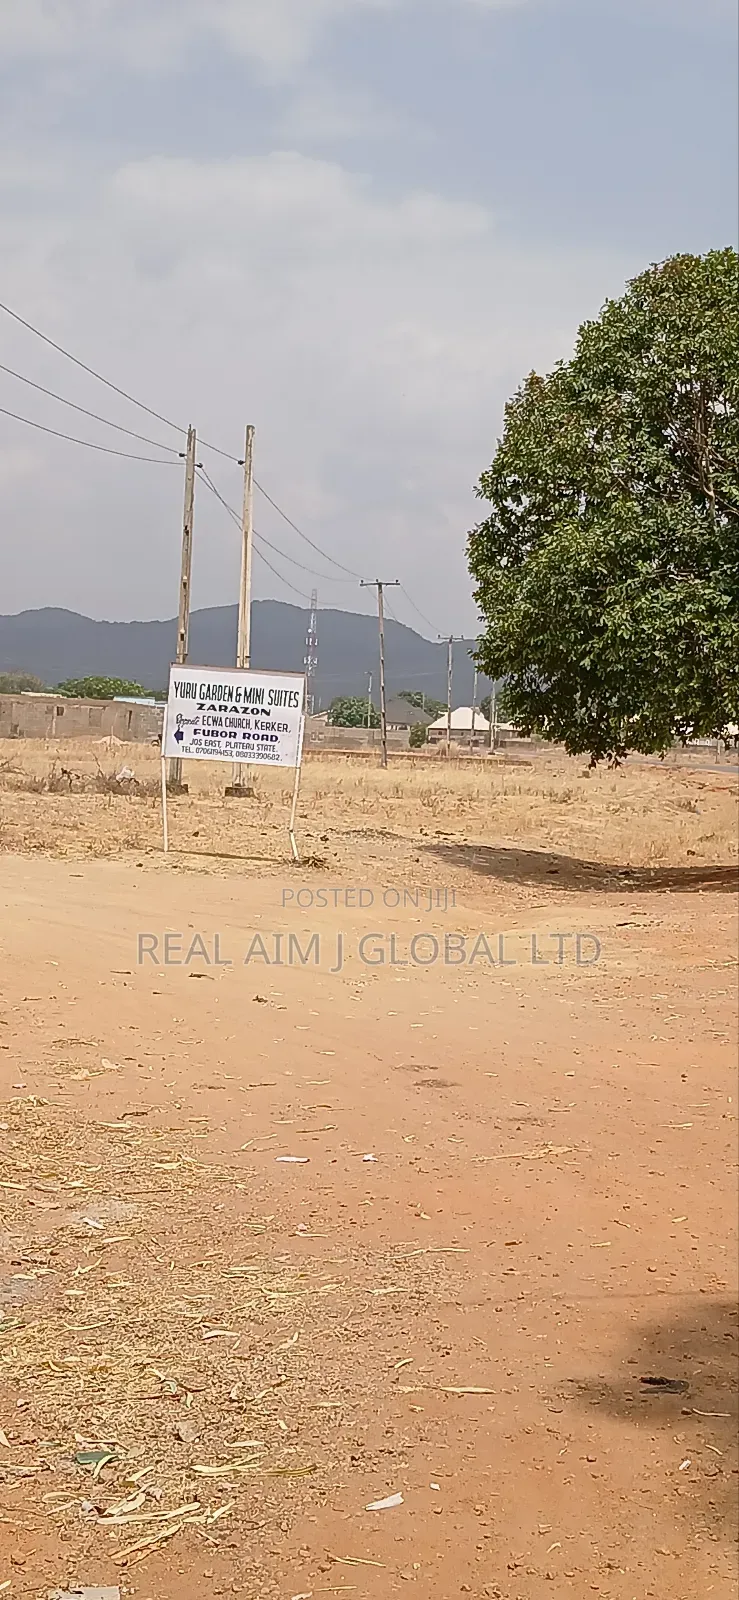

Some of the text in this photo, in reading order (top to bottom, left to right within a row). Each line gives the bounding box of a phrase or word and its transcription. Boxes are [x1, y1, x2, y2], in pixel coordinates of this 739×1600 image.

[174, 681, 299, 708] YURU GARDEN & MINI SUITES
[196, 703, 271, 716] ZARAZON
[202, 715, 223, 728] ECWA
[225, 717, 252, 730] CHURCH,
[193, 729, 280, 743] FUBOR ROAD,
[204, 740, 221, 748] EAST,
[225, 741, 254, 750] PLATEAU
[257, 744, 278, 752] STATE.
